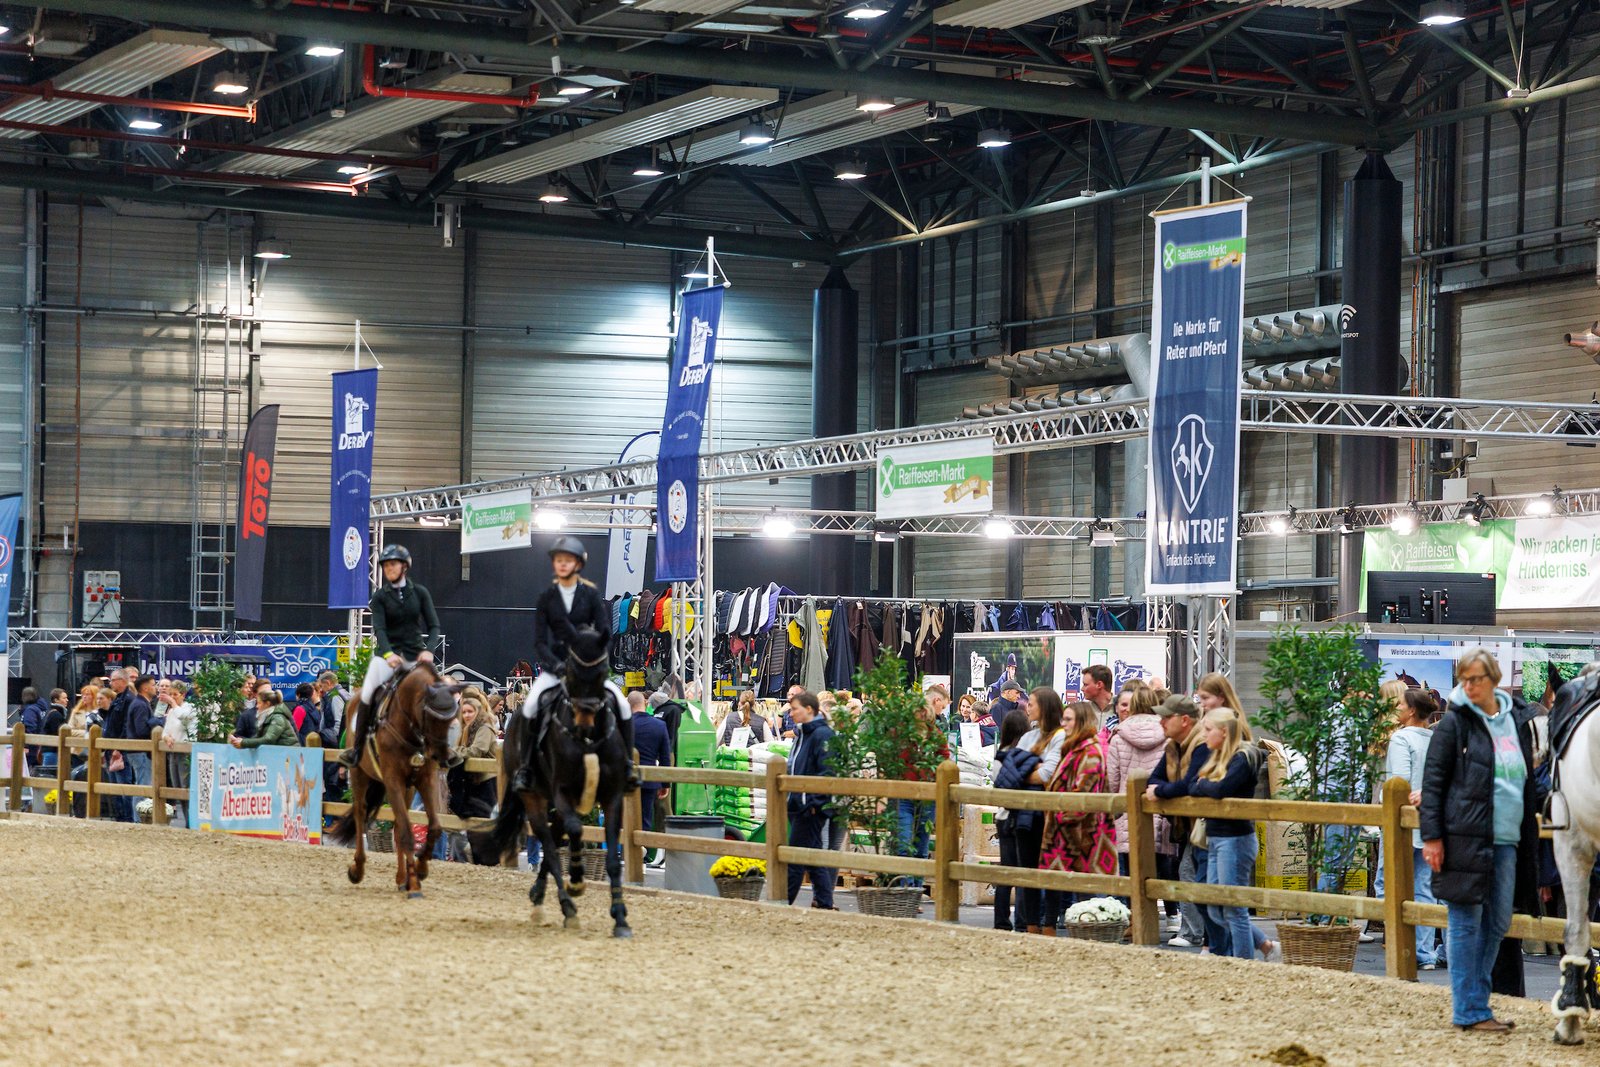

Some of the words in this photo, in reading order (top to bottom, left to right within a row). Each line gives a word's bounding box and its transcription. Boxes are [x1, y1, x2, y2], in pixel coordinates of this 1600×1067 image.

[1178, 244, 1227, 260] Raiffeisen-Markt
[1186, 320, 1206, 336] Marke
[1209, 317, 1222, 333] für
[1166, 344, 1189, 361] Reiter
[1189, 342, 1203, 358] und
[1203, 339, 1228, 356] Pferd
[338, 431, 371, 450] DERBY
[899, 463, 966, 485] Raiffeisen-Markt
[242, 451, 271, 540] TOYO
[475, 508, 516, 526] Raiffeisen-Markt
[1406, 541, 1455, 559] Raiffeisen
[1520, 537, 1542, 555] Wir
[1544, 535, 1588, 558] packen
[1166, 553, 1183, 567] Einfach
[1183, 553, 1193, 566] das
[1518, 560, 1591, 579] Hinderniss.
[1391, 648, 1441, 657] Weidezauntechnik
[219, 767, 228, 787] Im
[228, 763, 254, 790] Galopp
[255, 764, 267, 784] ins
[222, 790, 272, 817] Abenteuer
